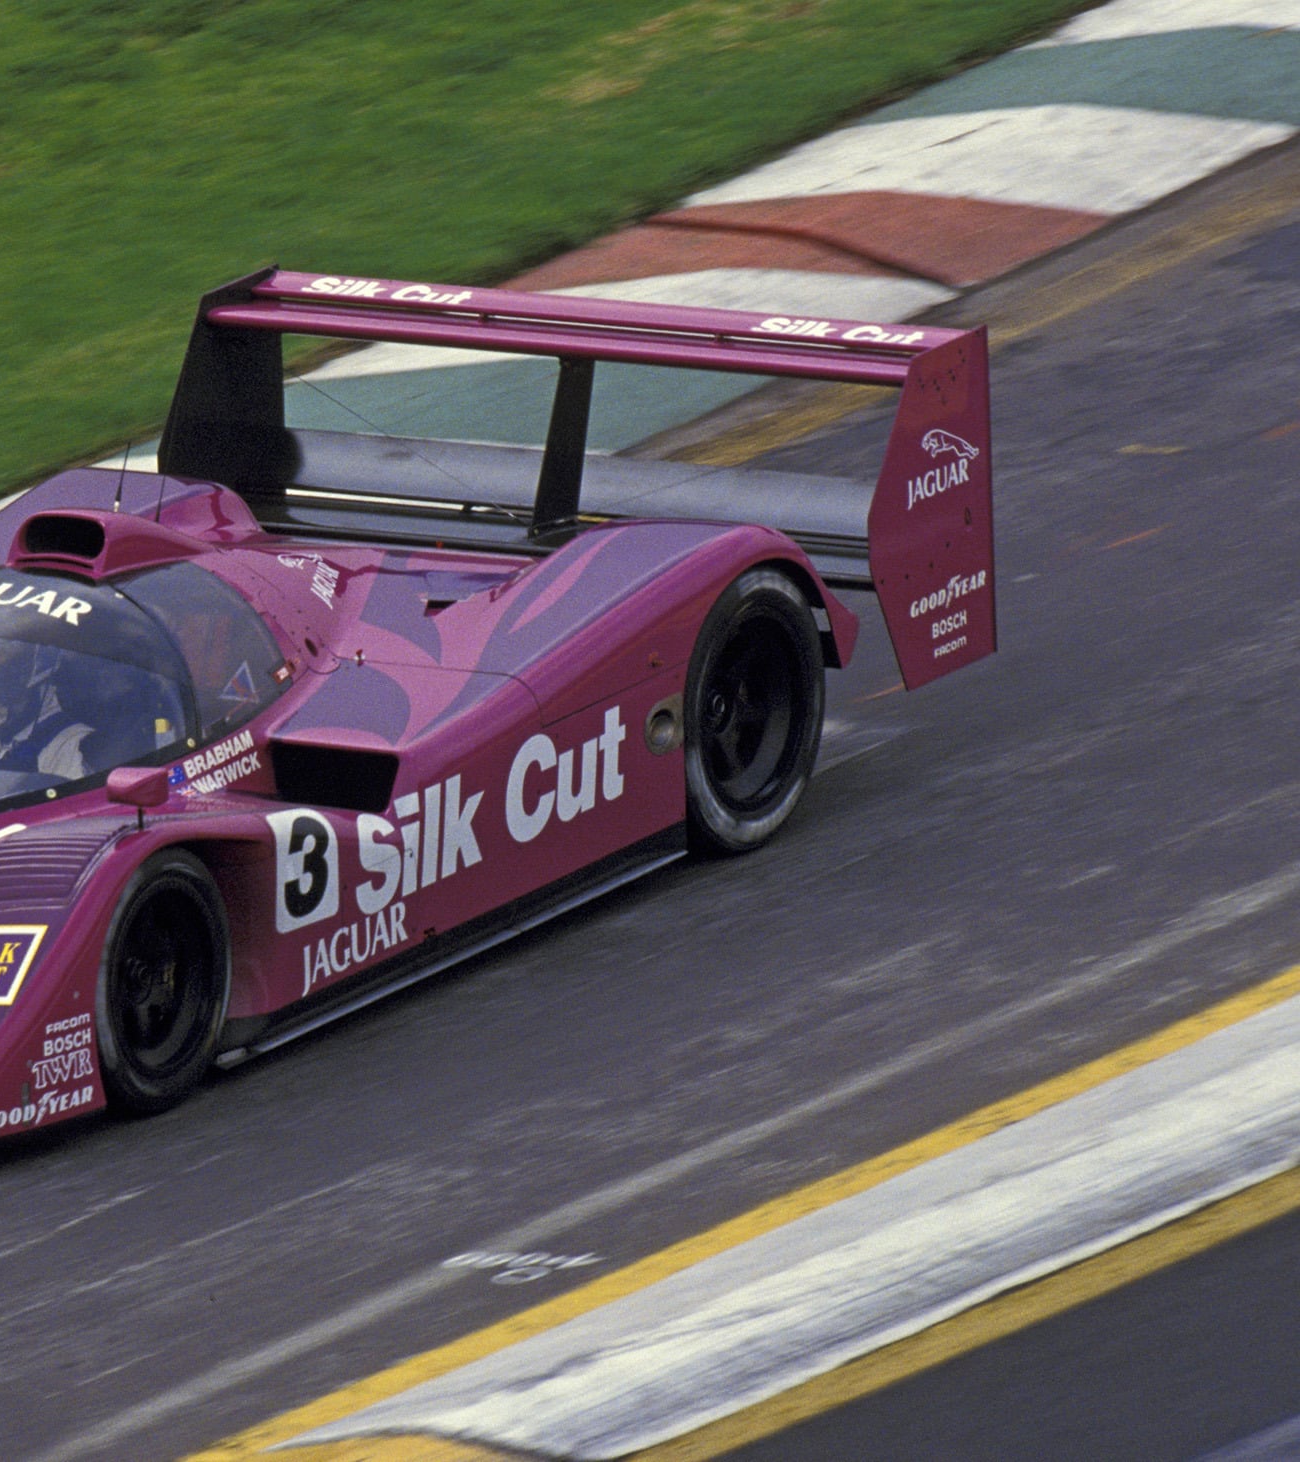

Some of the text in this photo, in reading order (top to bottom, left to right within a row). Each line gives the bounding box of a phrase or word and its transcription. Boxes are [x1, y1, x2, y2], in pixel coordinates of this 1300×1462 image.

[301, 277, 473, 305] Silk Cut
[751, 317, 925, 345] Silk Cut
[908, 458, 970, 510] JAGUAR
[932, 609, 967, 639] BOSCH
[183, 729, 254, 778] BRABHAM
[191, 751, 262, 794] WARWICK
[356, 704, 626, 915] Silk Cut
[284, 815, 330, 919] 3
[302, 901, 408, 998] JAGUAR
[43, 1028, 91, 1056] BOSCH
[31, 1047, 93, 1090] TWR
